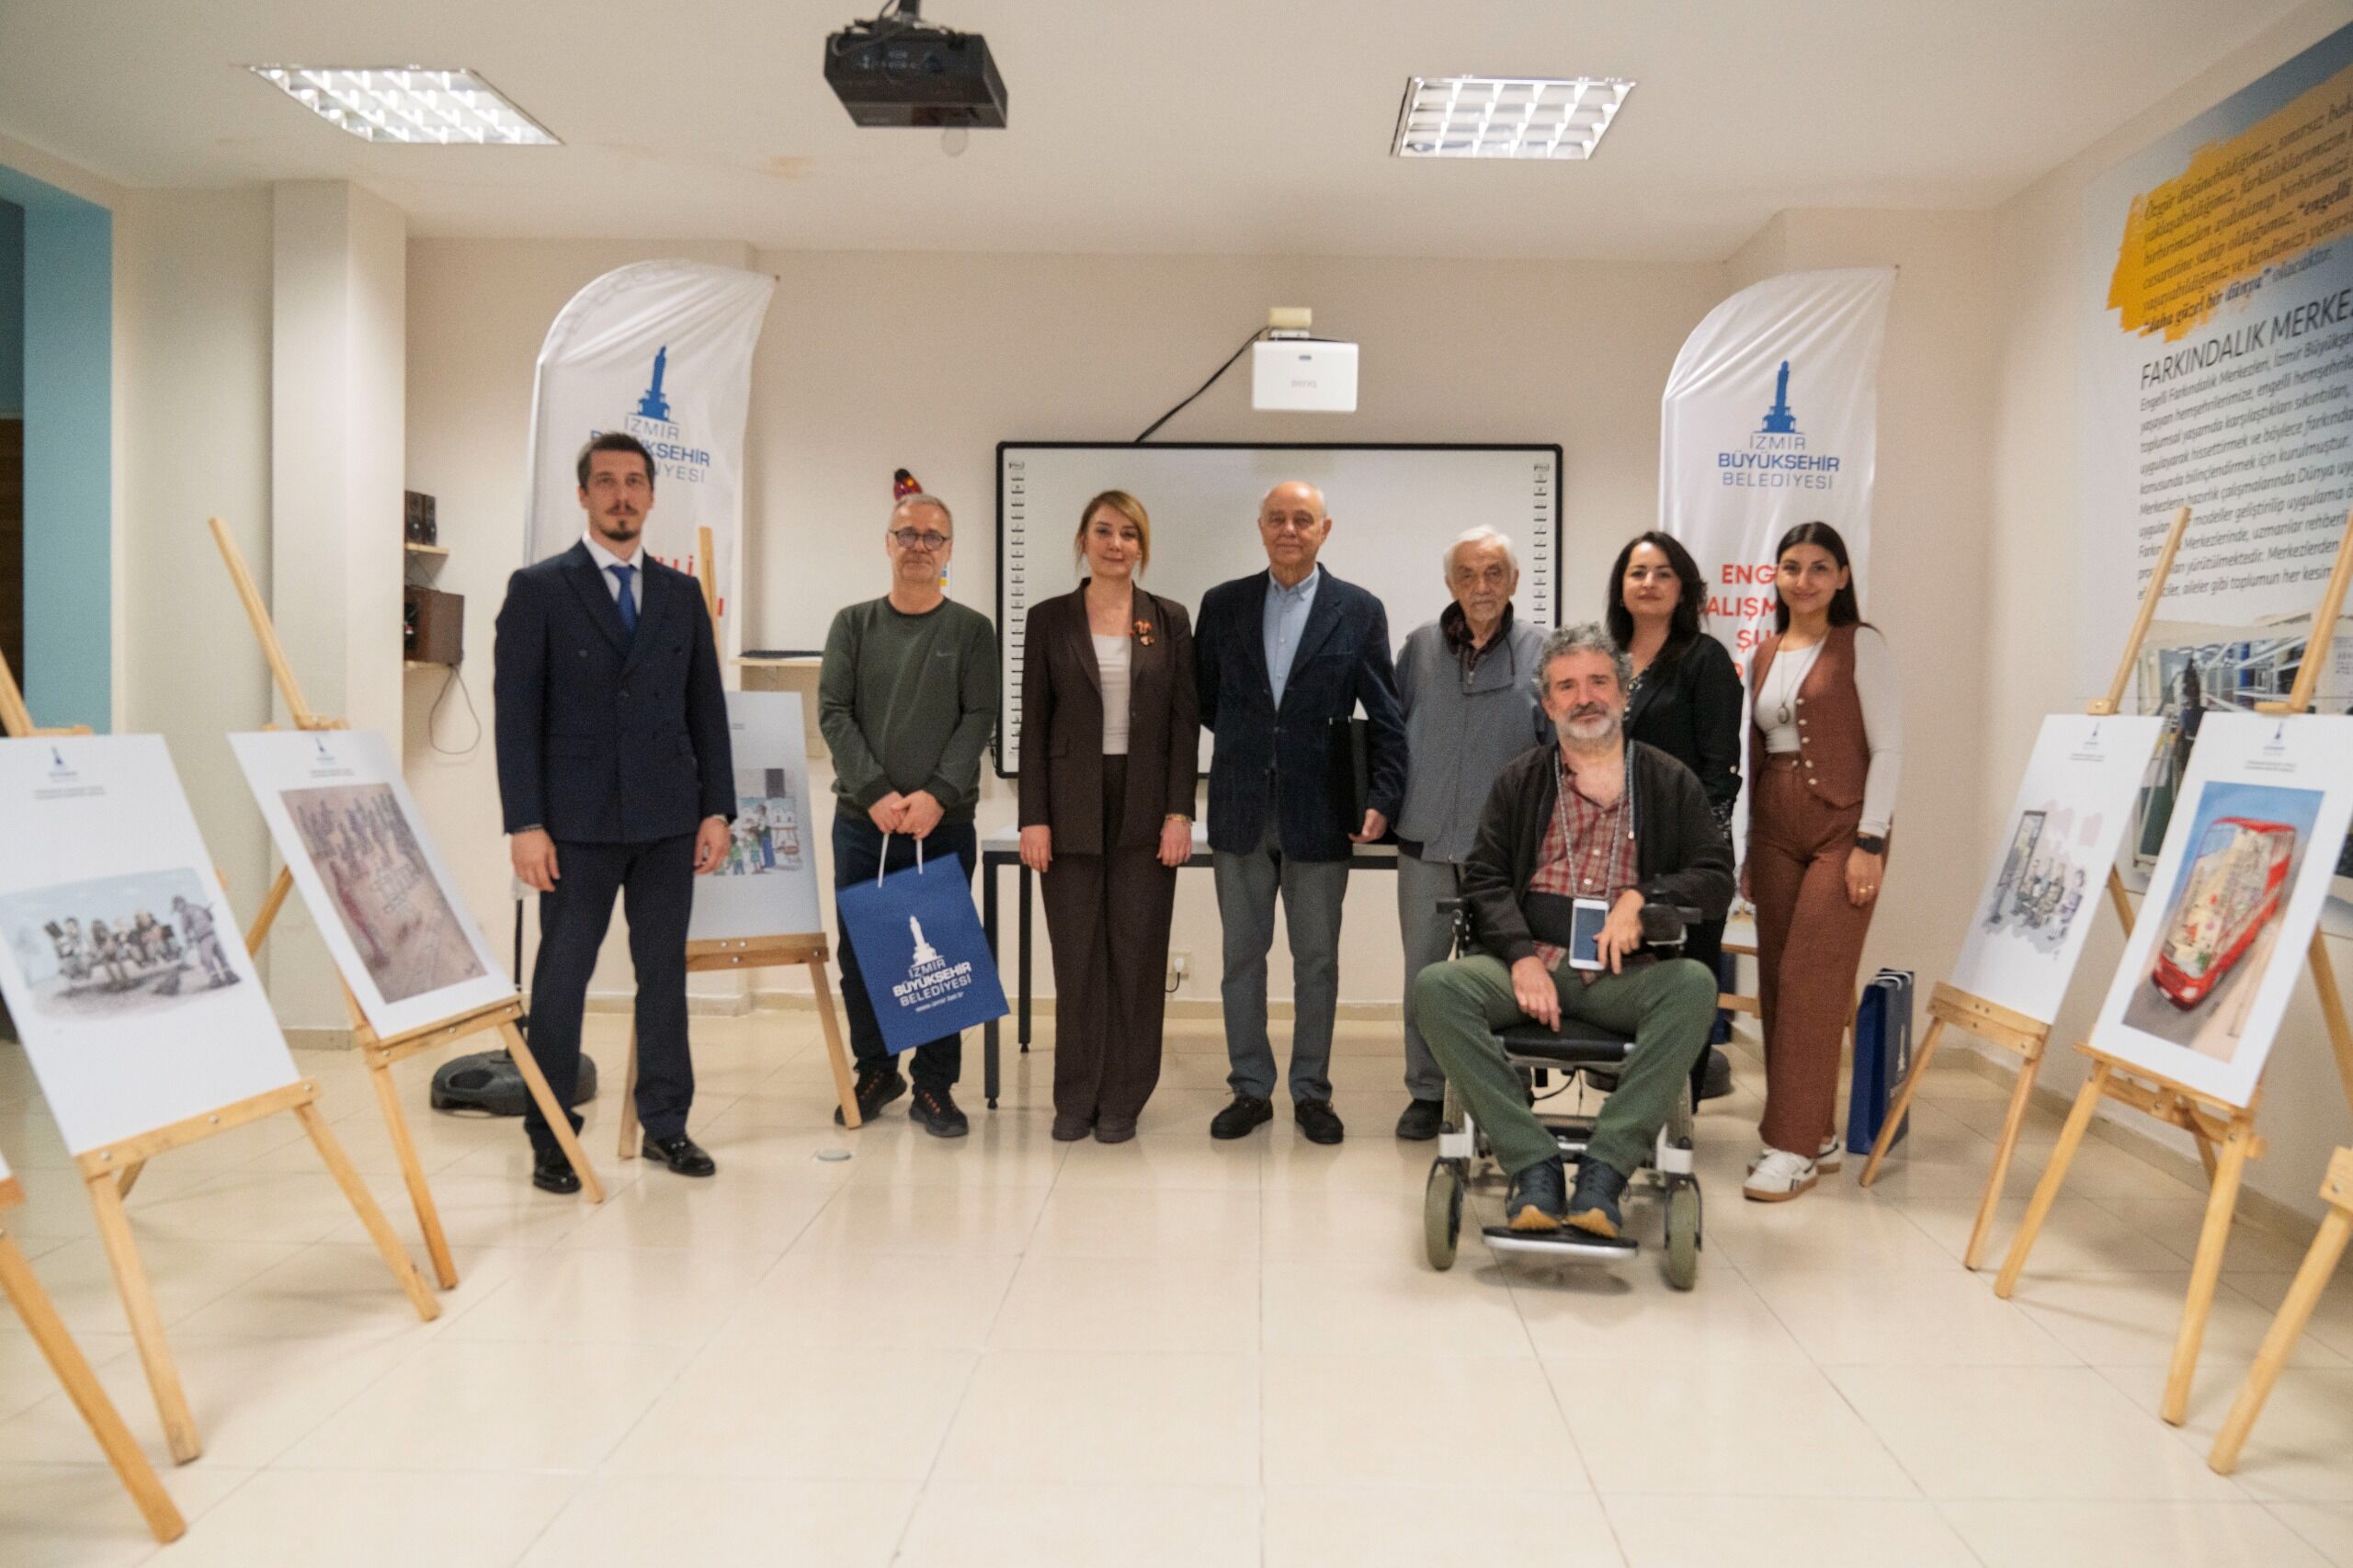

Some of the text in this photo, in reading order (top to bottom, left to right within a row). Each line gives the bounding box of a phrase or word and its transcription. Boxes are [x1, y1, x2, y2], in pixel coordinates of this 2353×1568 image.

[2141, 289, 2353, 391] FARKINDALIK MERKE
[2257, 372, 2291, 398] engelli
[624, 415, 680, 441] İZMİR
[1749, 433, 1806, 450] İZMİR
[2250, 433, 2262, 446] ve
[1718, 450, 1840, 472] BÜYÜKŞEHİR
[2257, 449, 2277, 470] için
[1722, 471, 1834, 490] BELEDİYESİ
[2298, 463, 2336, 483] Dünya
[1722, 563, 1779, 585] ENG
[2282, 567, 2302, 583] her
[1707, 596, 1776, 621] ALIŞM
[892, 961, 972, 998] BÜYÜKŞEHİR
[908, 958, 946, 979] İZMİR
[900, 974, 972, 1007] BELEDİYESİ
